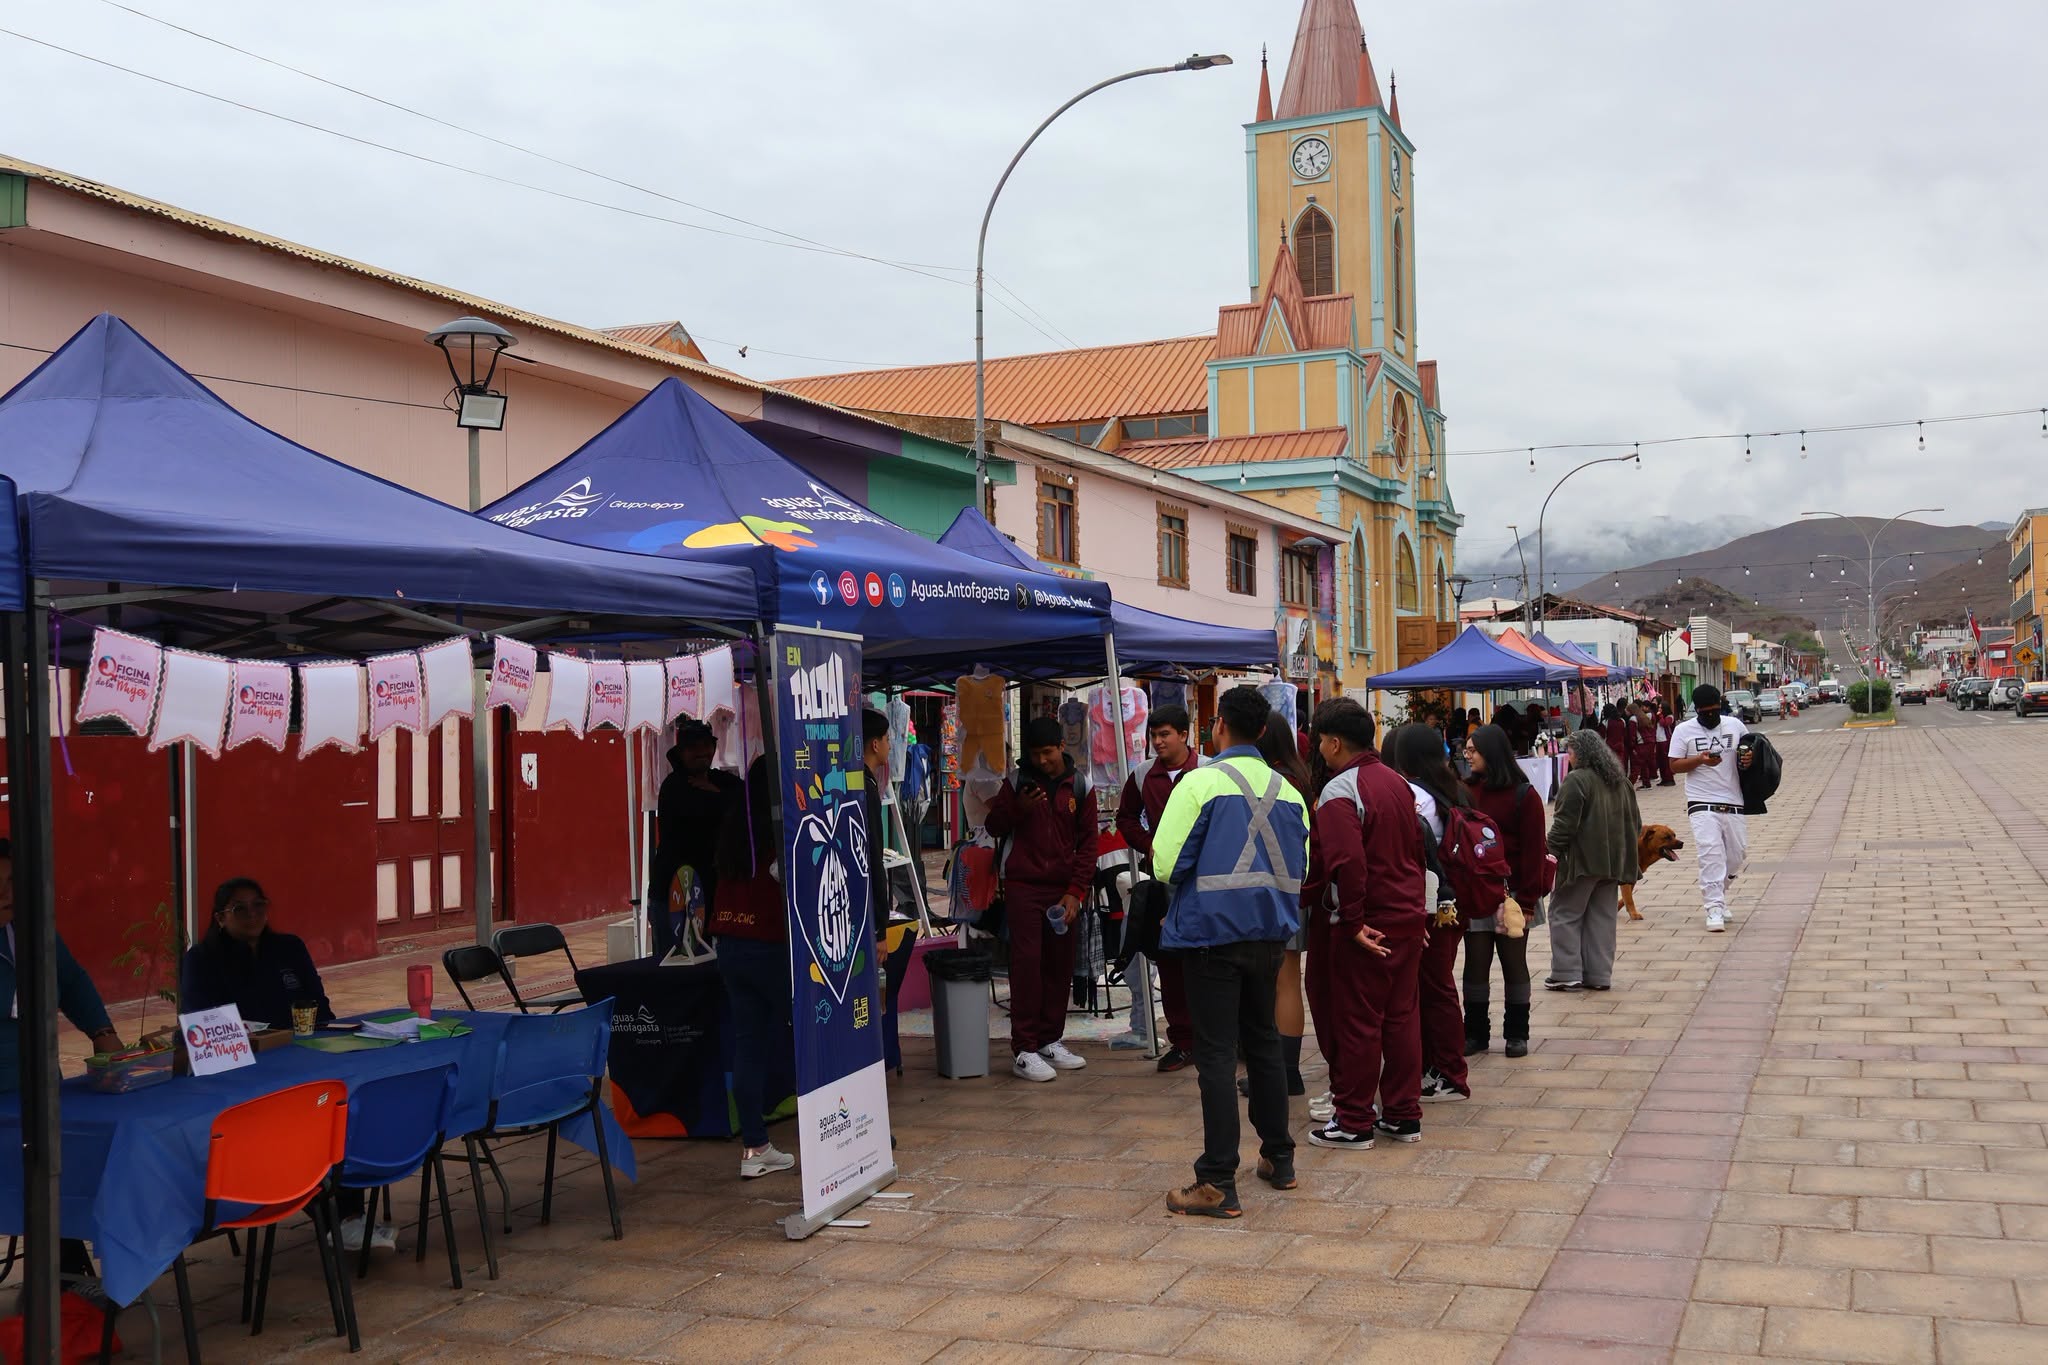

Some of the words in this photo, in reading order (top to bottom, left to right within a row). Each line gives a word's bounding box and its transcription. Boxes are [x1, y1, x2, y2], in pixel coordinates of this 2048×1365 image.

[489, 503, 542, 522] guas
[761, 497, 823, 510] aguas
[506, 507, 588, 528] fagasta
[911, 579, 1010, 603] Aguas.Antofagasta
[787, 647, 802, 666] EN
[98, 656, 150, 681] OFICINA
[499, 658, 530, 678] OFICINA
[118, 675, 150, 687] MUNICIPAL
[377, 680, 415, 699] OFICINA
[509, 678, 529, 694] Mujer
[790, 651, 849, 721] TALTAL
[116, 681, 148, 703] Mujer
[240, 685, 284, 708] OFICINA
[393, 695, 416, 710] Mujer
[257, 706, 284, 723] Mujer
[805, 724, 840, 741] TOMAMOS
[1695, 734, 1733, 752] EA7
[187, 1022, 241, 1049] OFICINA
[610, 1023, 660, 1034] antofagasta
[212, 1033, 244, 1044] MUNICIPAL
[213, 1041, 248, 1062] Mujer
[820, 1112, 837, 1129] aguas
[820, 1119, 852, 1142] antofagasta
